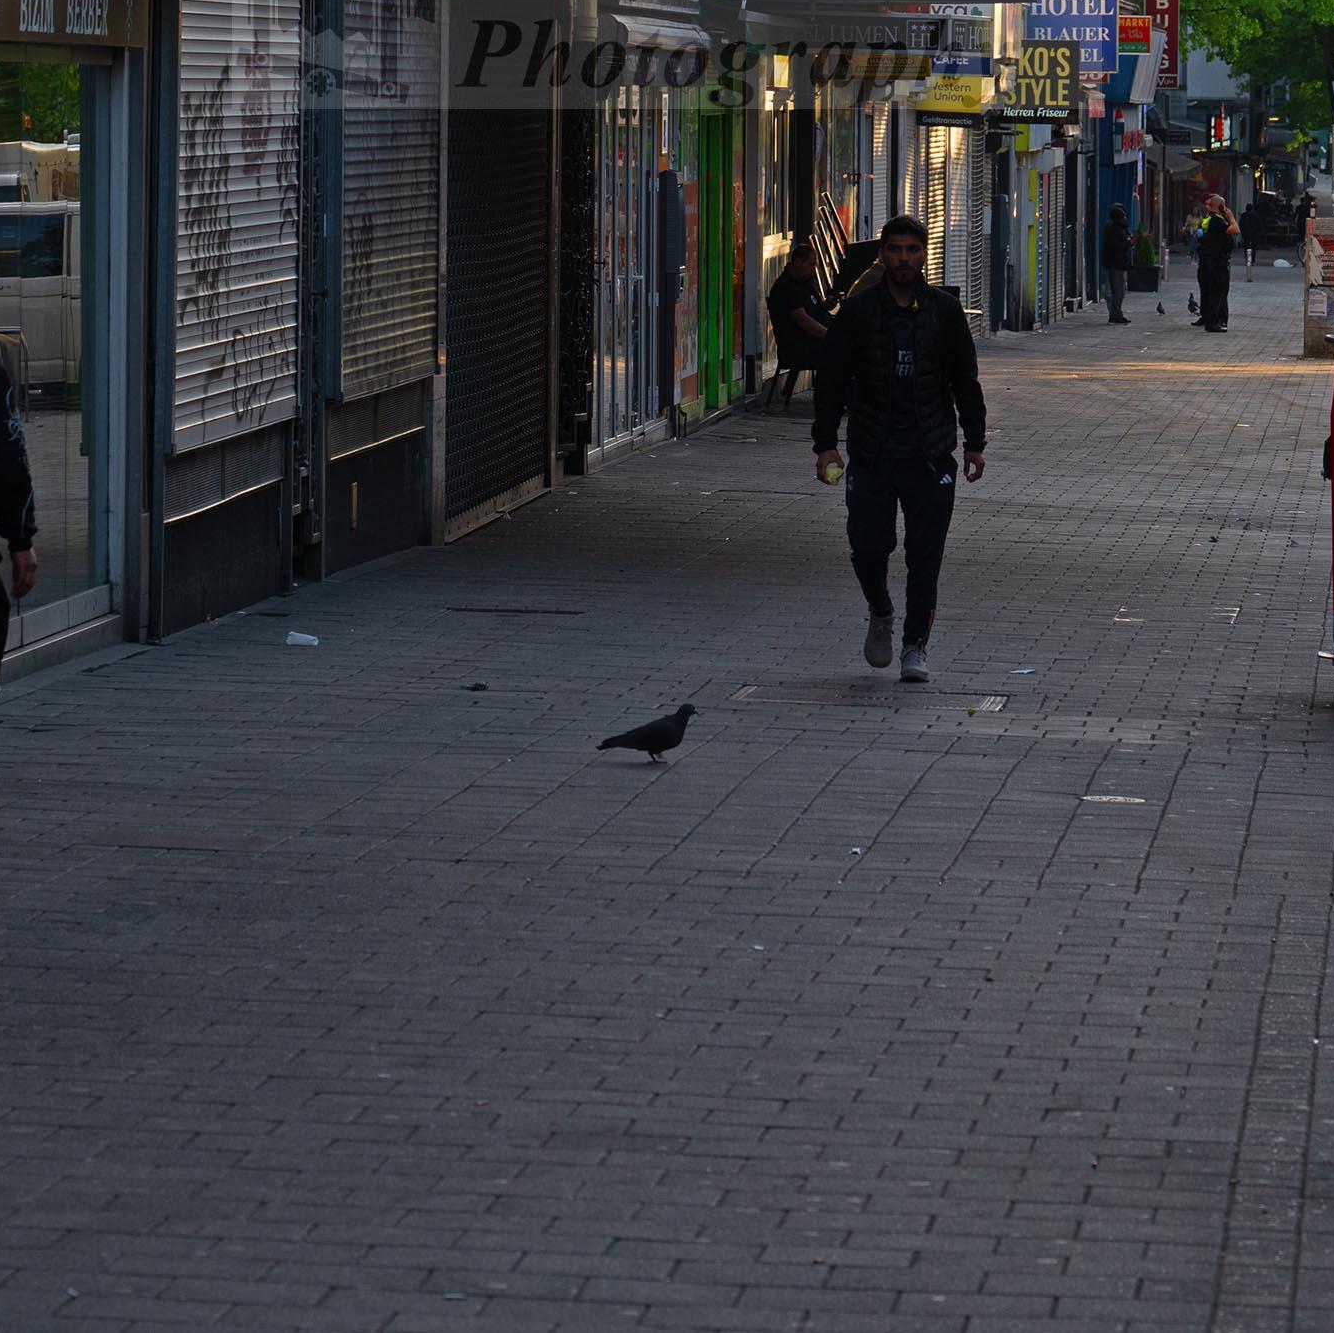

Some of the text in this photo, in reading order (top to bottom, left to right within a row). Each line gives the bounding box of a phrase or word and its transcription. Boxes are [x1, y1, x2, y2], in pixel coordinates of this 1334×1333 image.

[829, 24, 900, 44] LUMEN
[1034, 26, 1111, 42] BLAUER
[933, 92, 964, 102] Union
[1003, 106, 1070, 118] Herren Friseur
